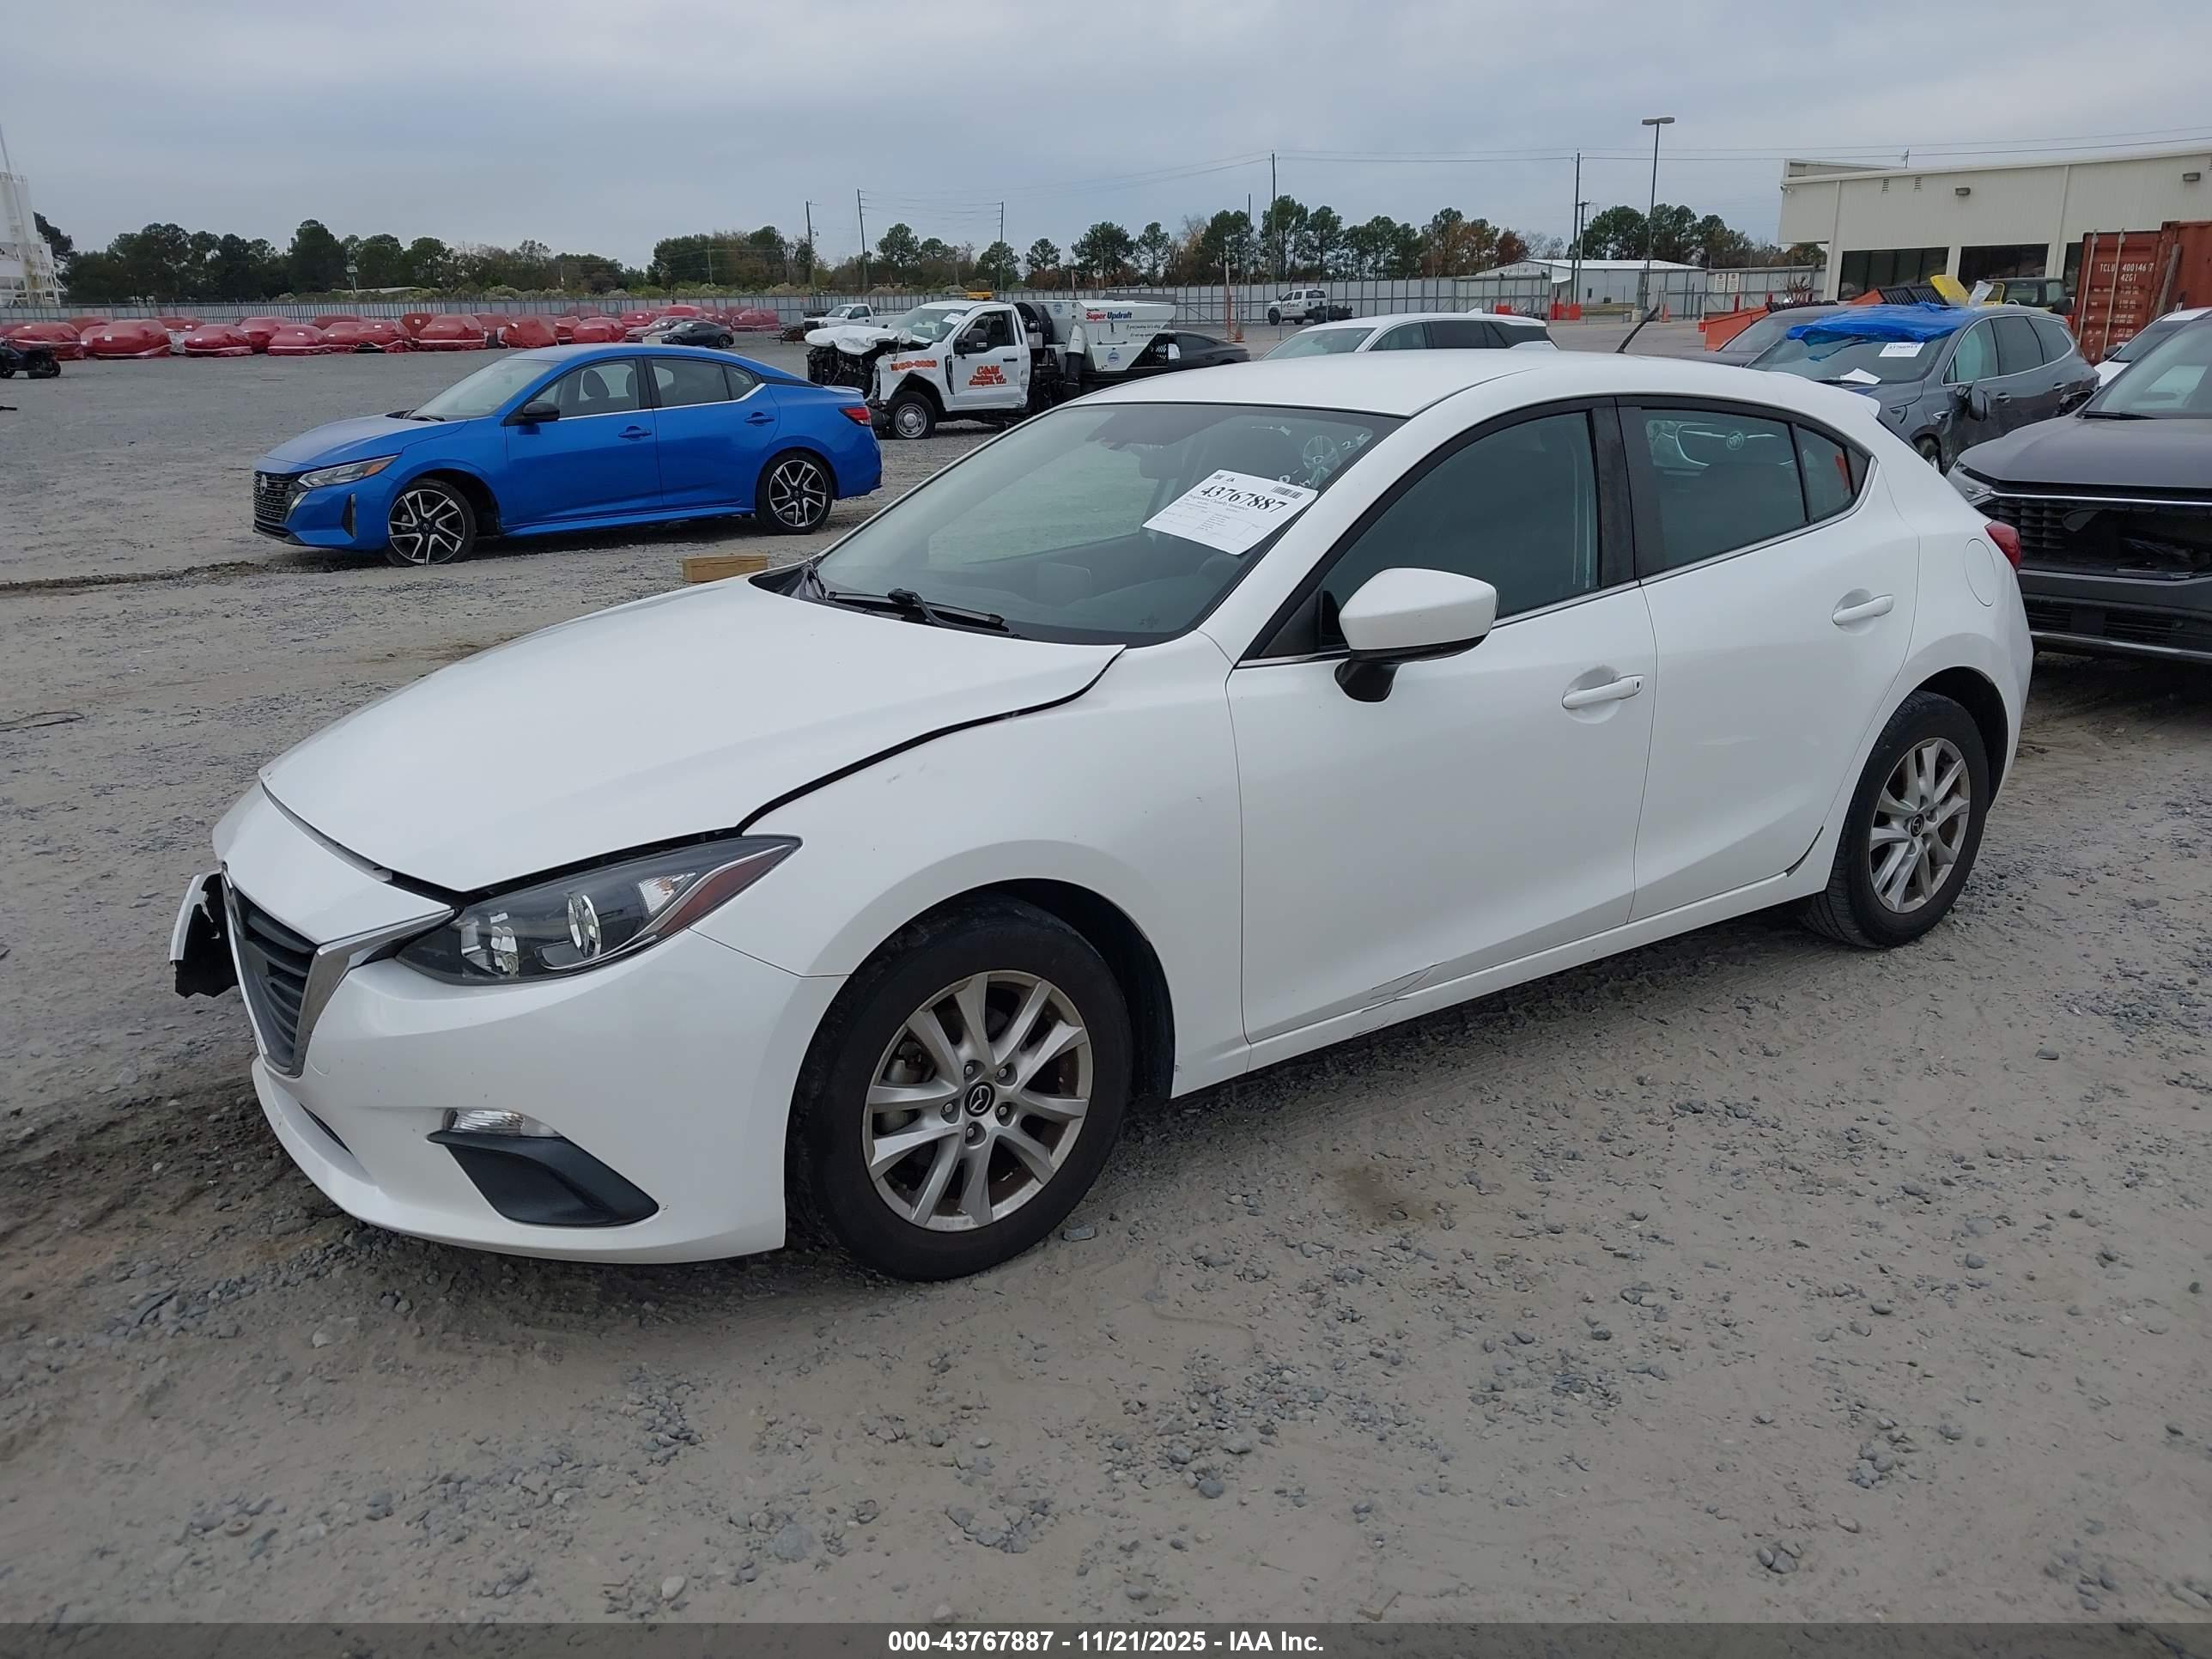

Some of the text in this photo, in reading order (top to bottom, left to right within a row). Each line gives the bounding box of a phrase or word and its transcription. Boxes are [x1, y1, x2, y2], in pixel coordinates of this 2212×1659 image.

[2122, 263, 2147, 272] 400146
[1085, 310, 1133, 321] Super Updraft
[1200, 484, 1288, 514] 43767887
